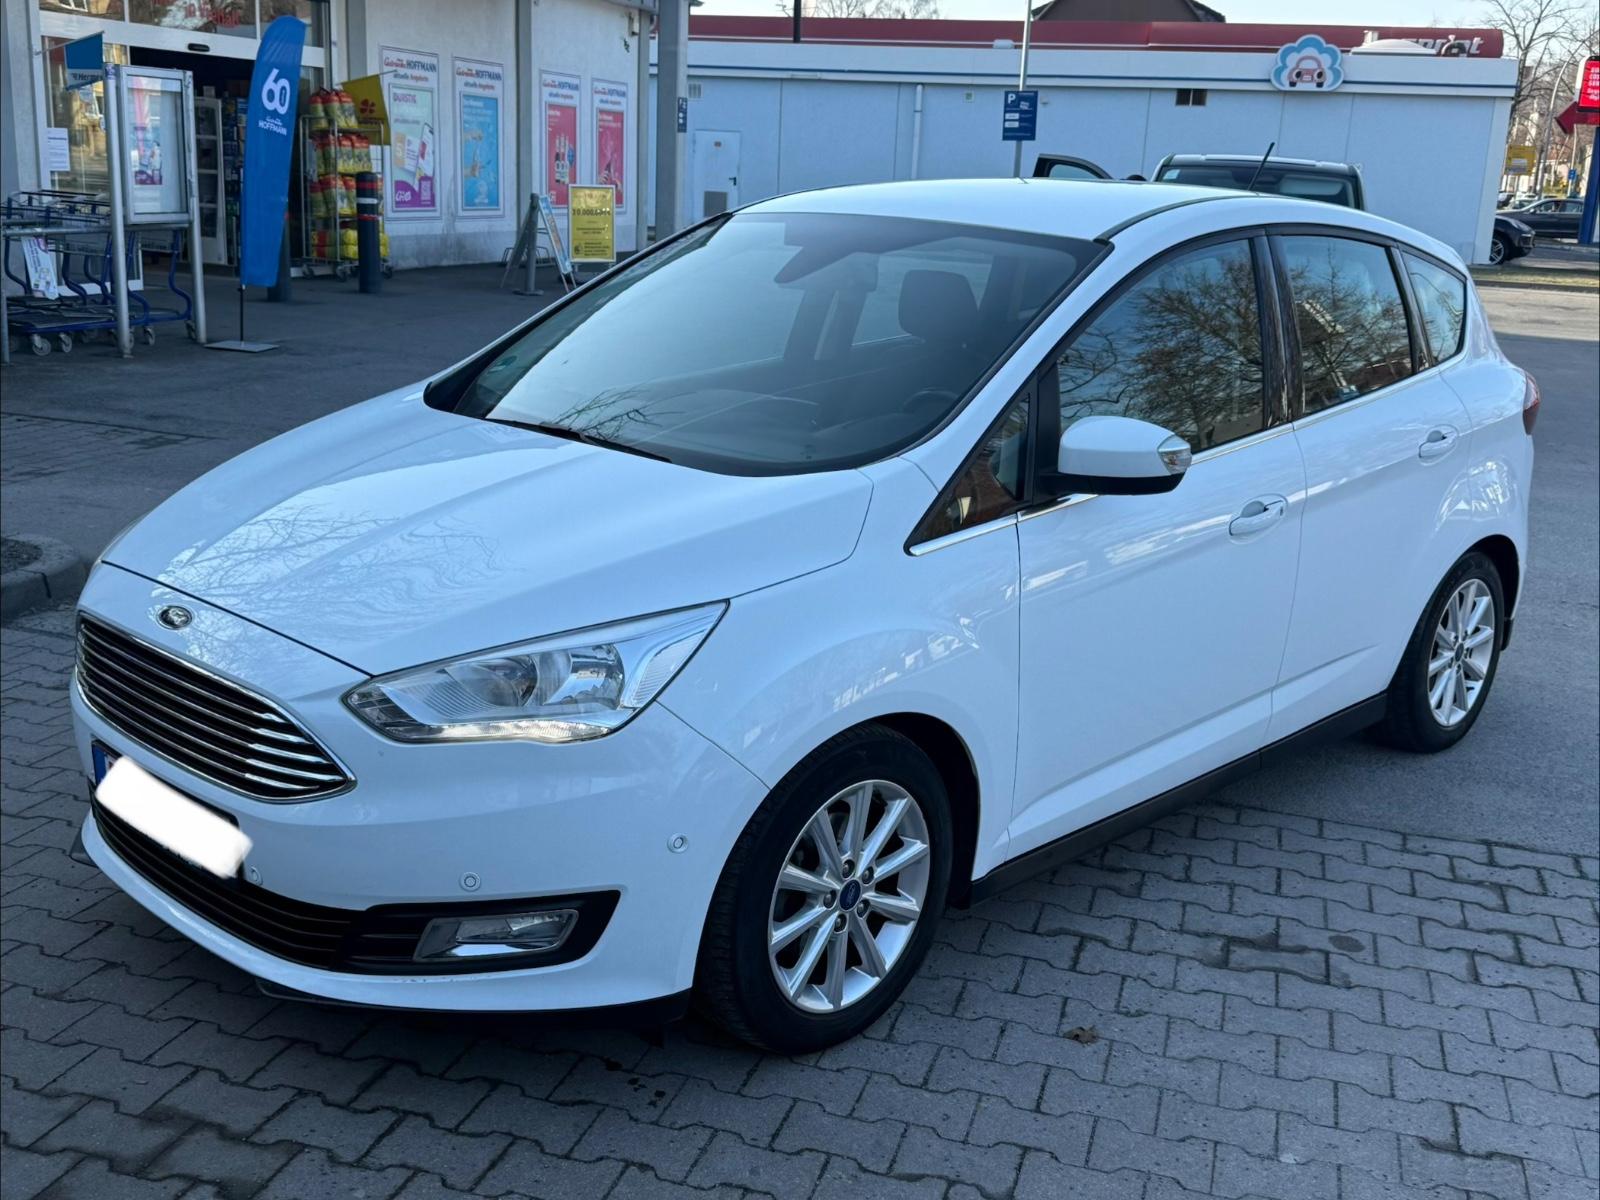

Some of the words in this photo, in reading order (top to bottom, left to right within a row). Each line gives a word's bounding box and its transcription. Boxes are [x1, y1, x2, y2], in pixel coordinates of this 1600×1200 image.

[406, 60, 437, 72] HOFFMANN
[475, 69, 502, 81] HOFFMANN
[261, 67, 290, 115] 60
[1007, 93, 1016, 104] P
[258, 120, 287, 136] HOFFMANN
